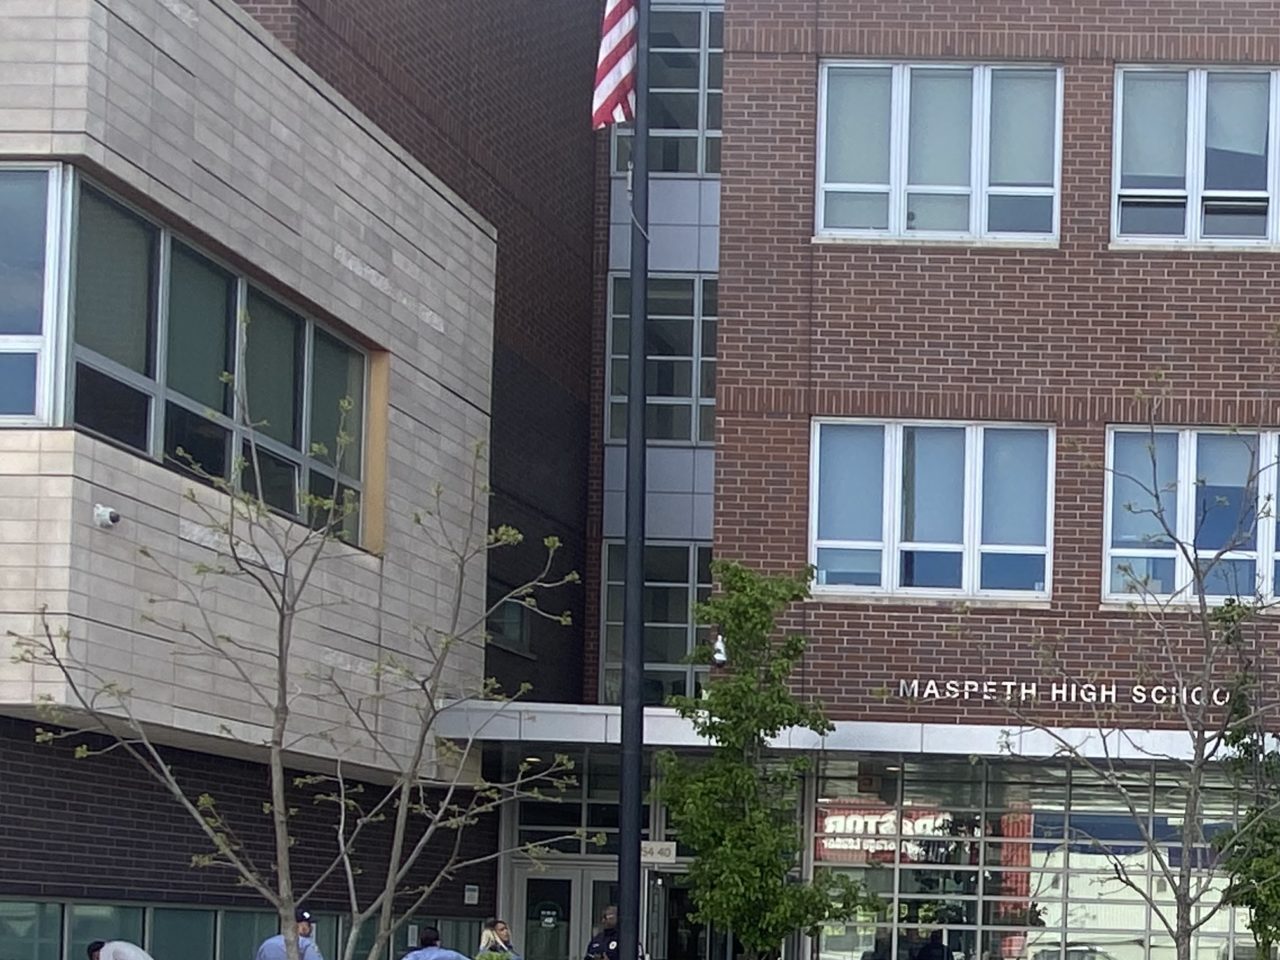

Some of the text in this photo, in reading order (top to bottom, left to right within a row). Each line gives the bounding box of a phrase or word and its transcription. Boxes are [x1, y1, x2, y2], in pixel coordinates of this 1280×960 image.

[899, 679, 1232, 706] MASPETH HIGH SCHOO
